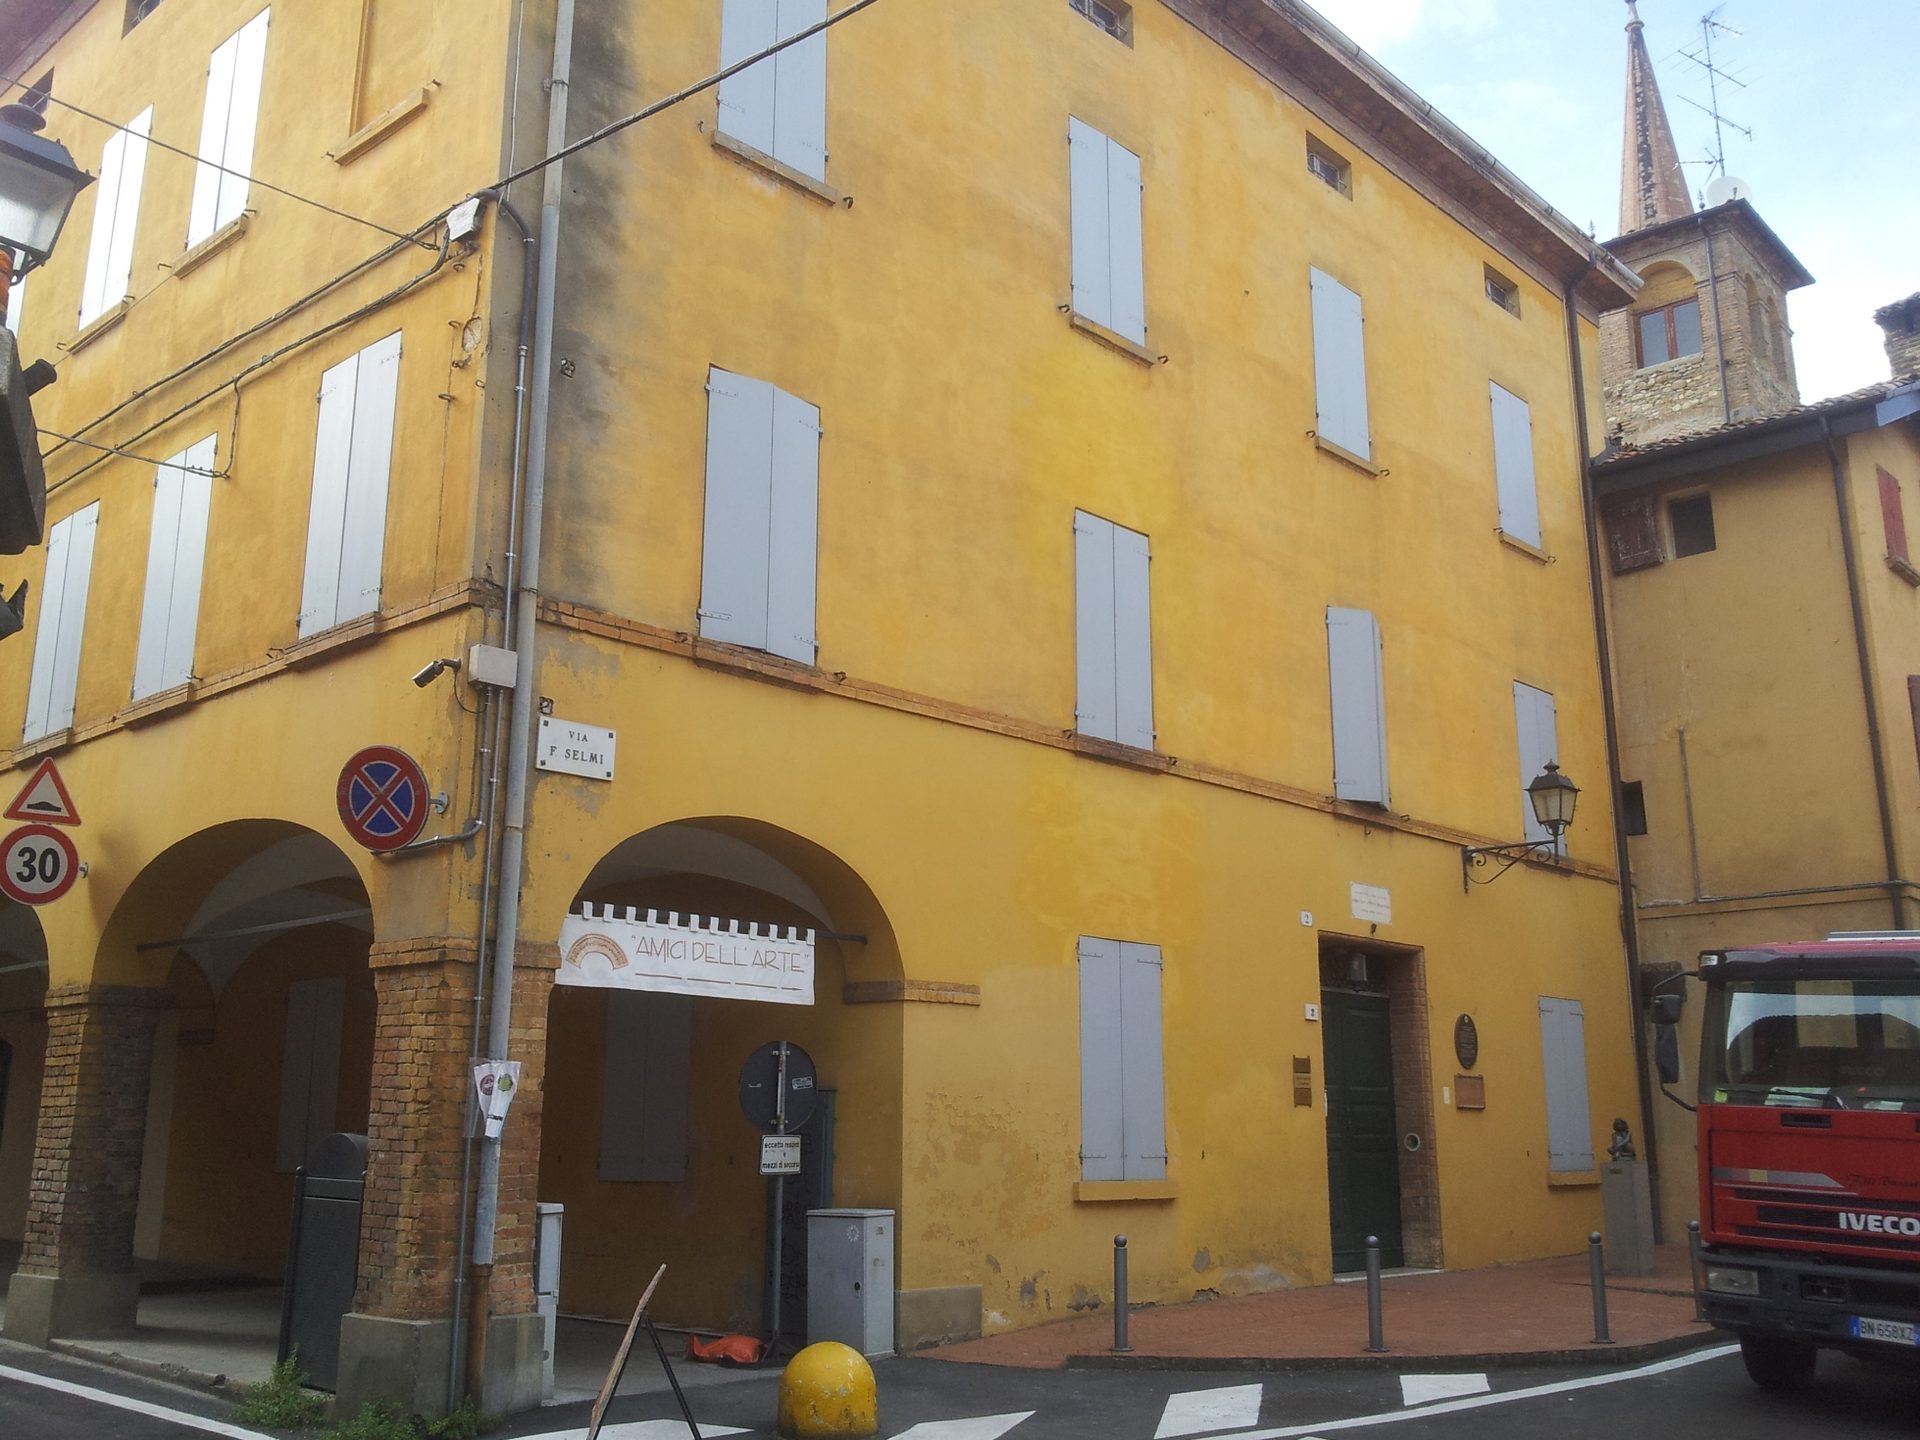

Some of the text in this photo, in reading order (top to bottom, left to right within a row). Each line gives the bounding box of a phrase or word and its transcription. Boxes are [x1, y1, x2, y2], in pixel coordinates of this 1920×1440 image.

[569, 730, 588, 742] VIA
[564, 748, 604, 765] SELMI
[16, 846, 60, 883] 30
[1839, 1212, 1920, 1236] IVECO
[1861, 1320, 1875, 1336] BN
